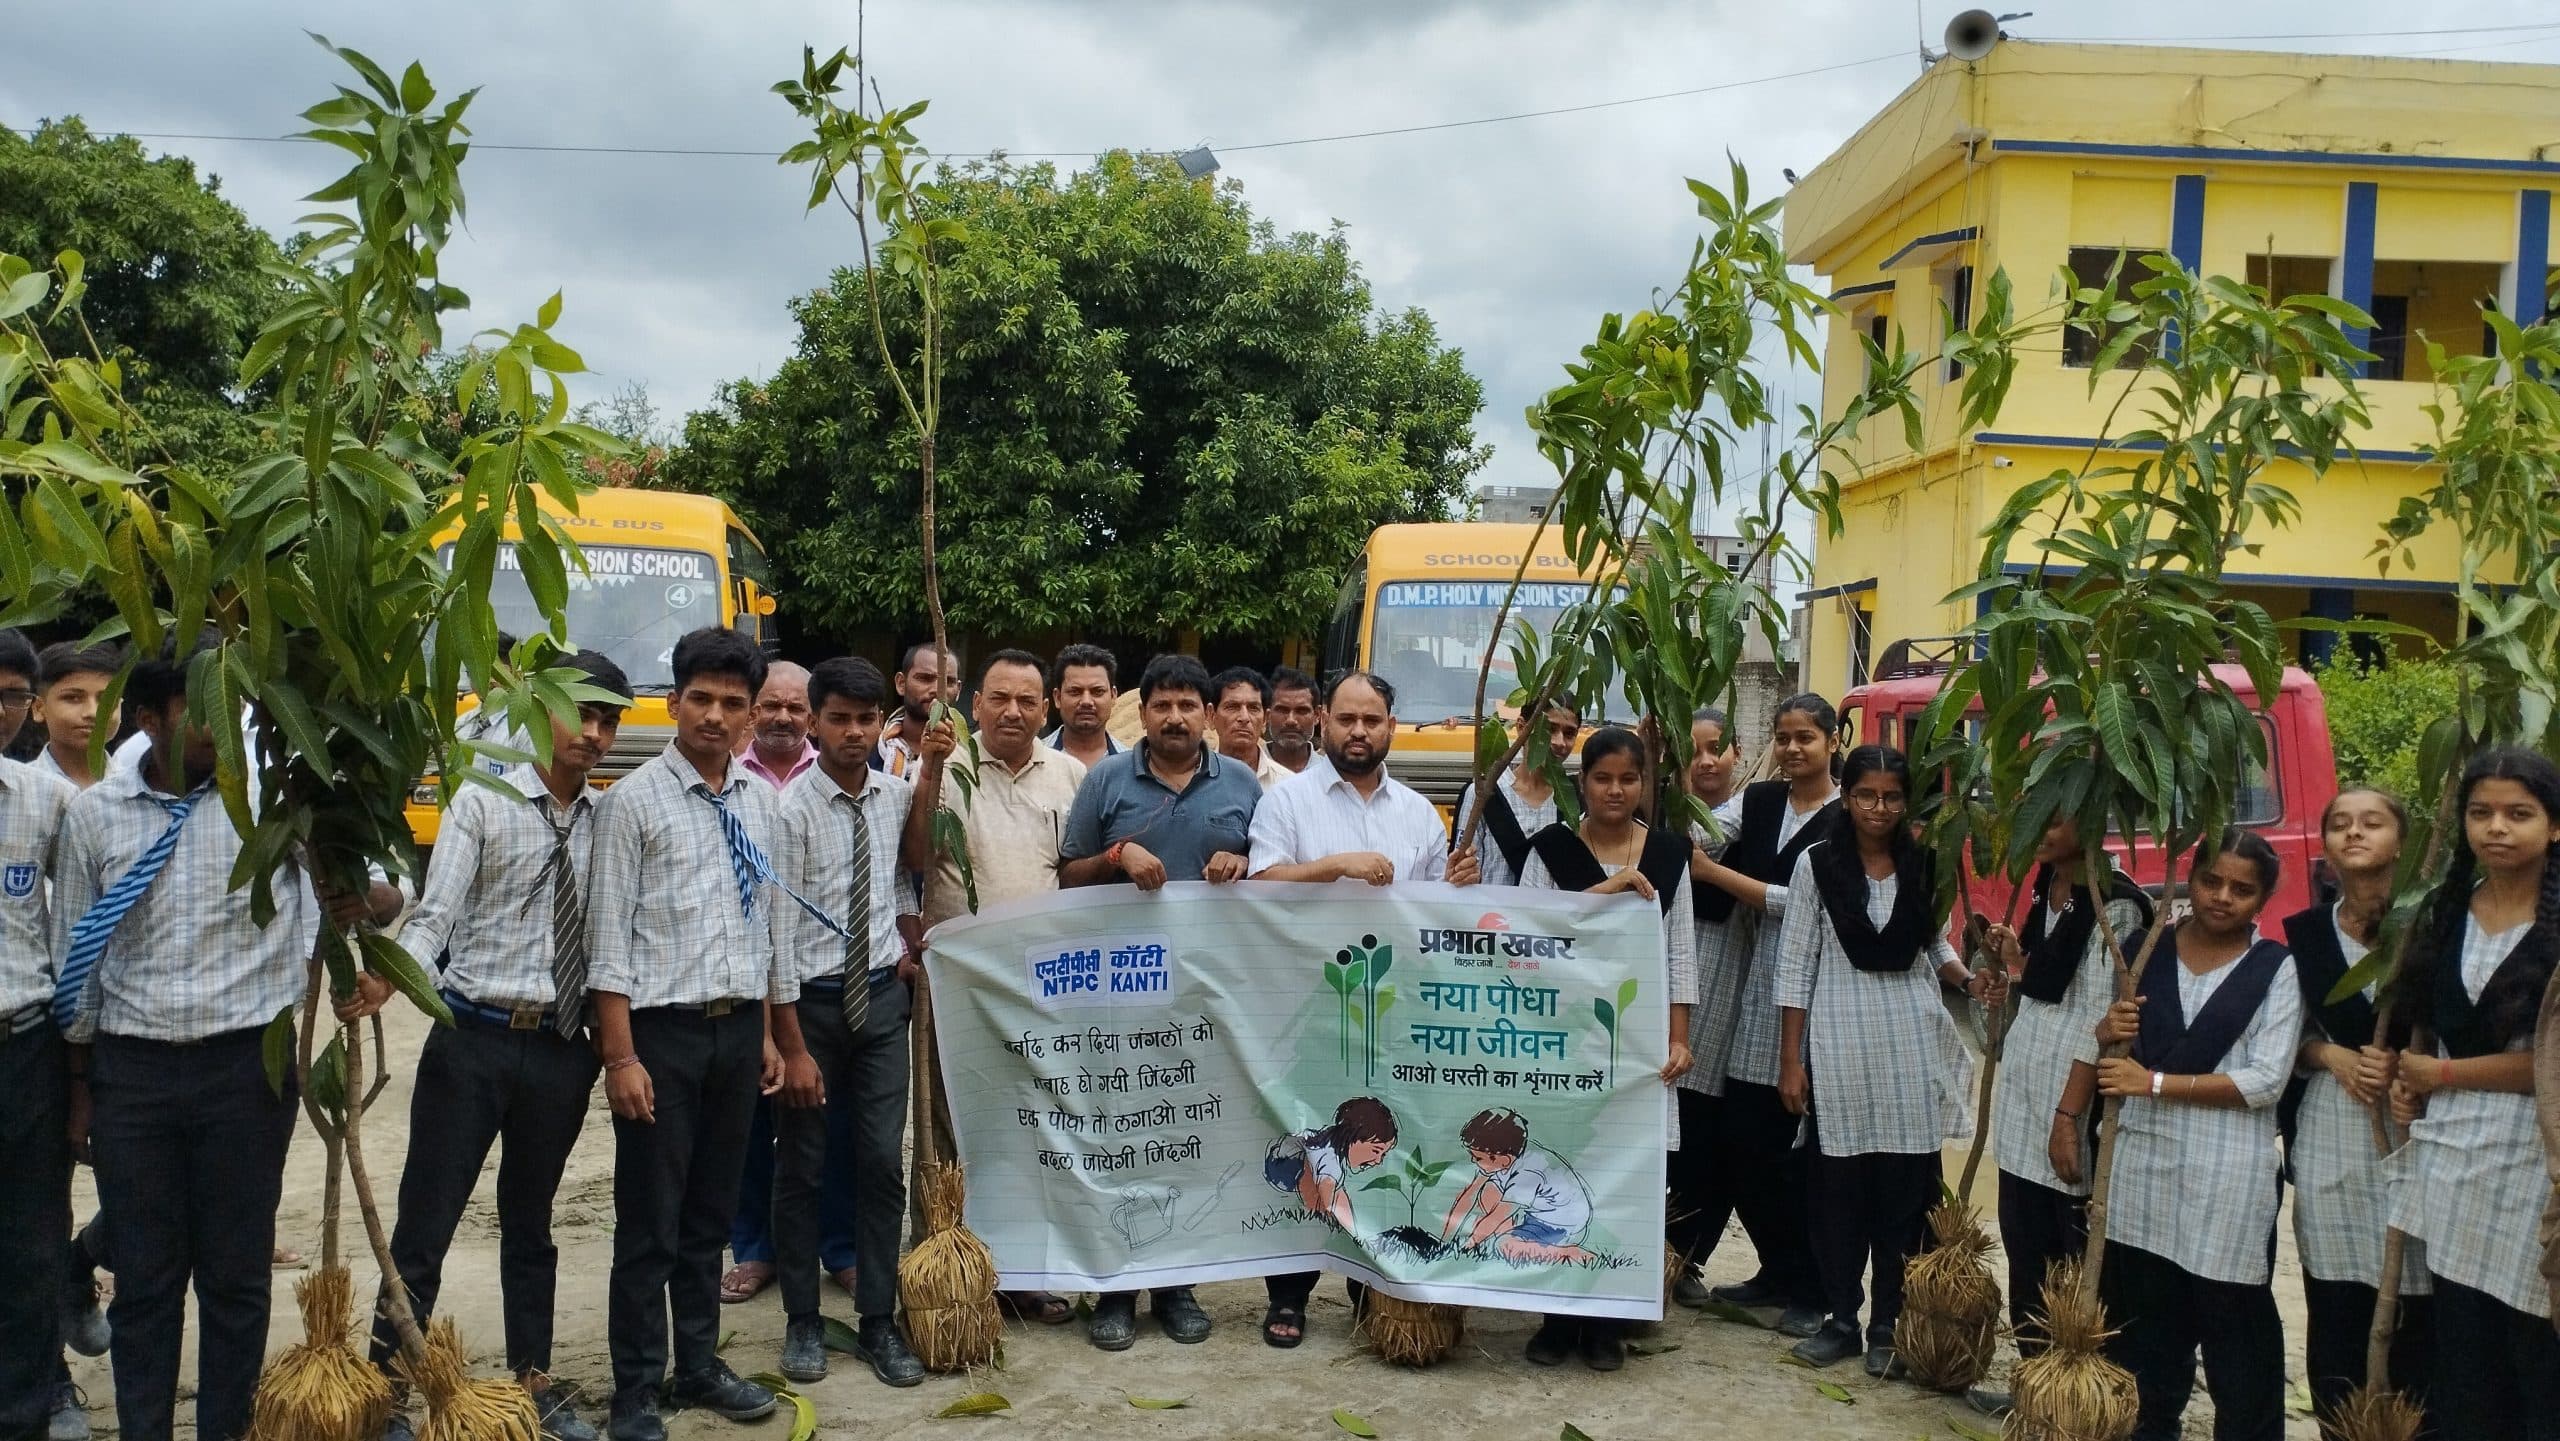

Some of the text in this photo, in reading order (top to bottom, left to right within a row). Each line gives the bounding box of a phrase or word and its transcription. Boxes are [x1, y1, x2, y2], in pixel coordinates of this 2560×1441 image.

[613, 519, 664, 530] BUS
[631, 552, 703, 579] SCHOOL
[1536, 554, 1577, 568] BU
[670, 586, 688, 604] 4
[1440, 584, 1485, 606] HOLY
[1419, 929, 1577, 959] प्रभात खबर
[1034, 949, 1101, 980] एनटीपीसी
[1043, 970, 1169, 997] NTPC KANTI
[1419, 975, 1561, 1017] नया पौधा
[1051, 1034, 1082, 1054] कर
[1087, 1026, 1121, 1055] दिया
[1127, 1021, 1183, 1050] जंगलों
[1190, 1015, 1214, 1042] को
[1410, 1017, 1569, 1061] नया जीवन
[1076, 1065, 1093, 1093] हो
[1096, 1066, 1130, 1094] गयी
[1136, 1058, 1196, 1090] जिंदगी
[1391, 1060, 1438, 1085] आओ
[1442, 1063, 1489, 1088] धरती
[1493, 1070, 1519, 1089] का
[1575, 1069, 1604, 1092] करें
[1017, 1108, 1040, 1129] एक
[1091, 1105, 1107, 1134] तो
[1113, 1098, 1176, 1132] लगाओ
[1184, 1092, 1222, 1122] यारों
[1038, 1134, 1201, 1173] बदल जायेगी जिंदगी
